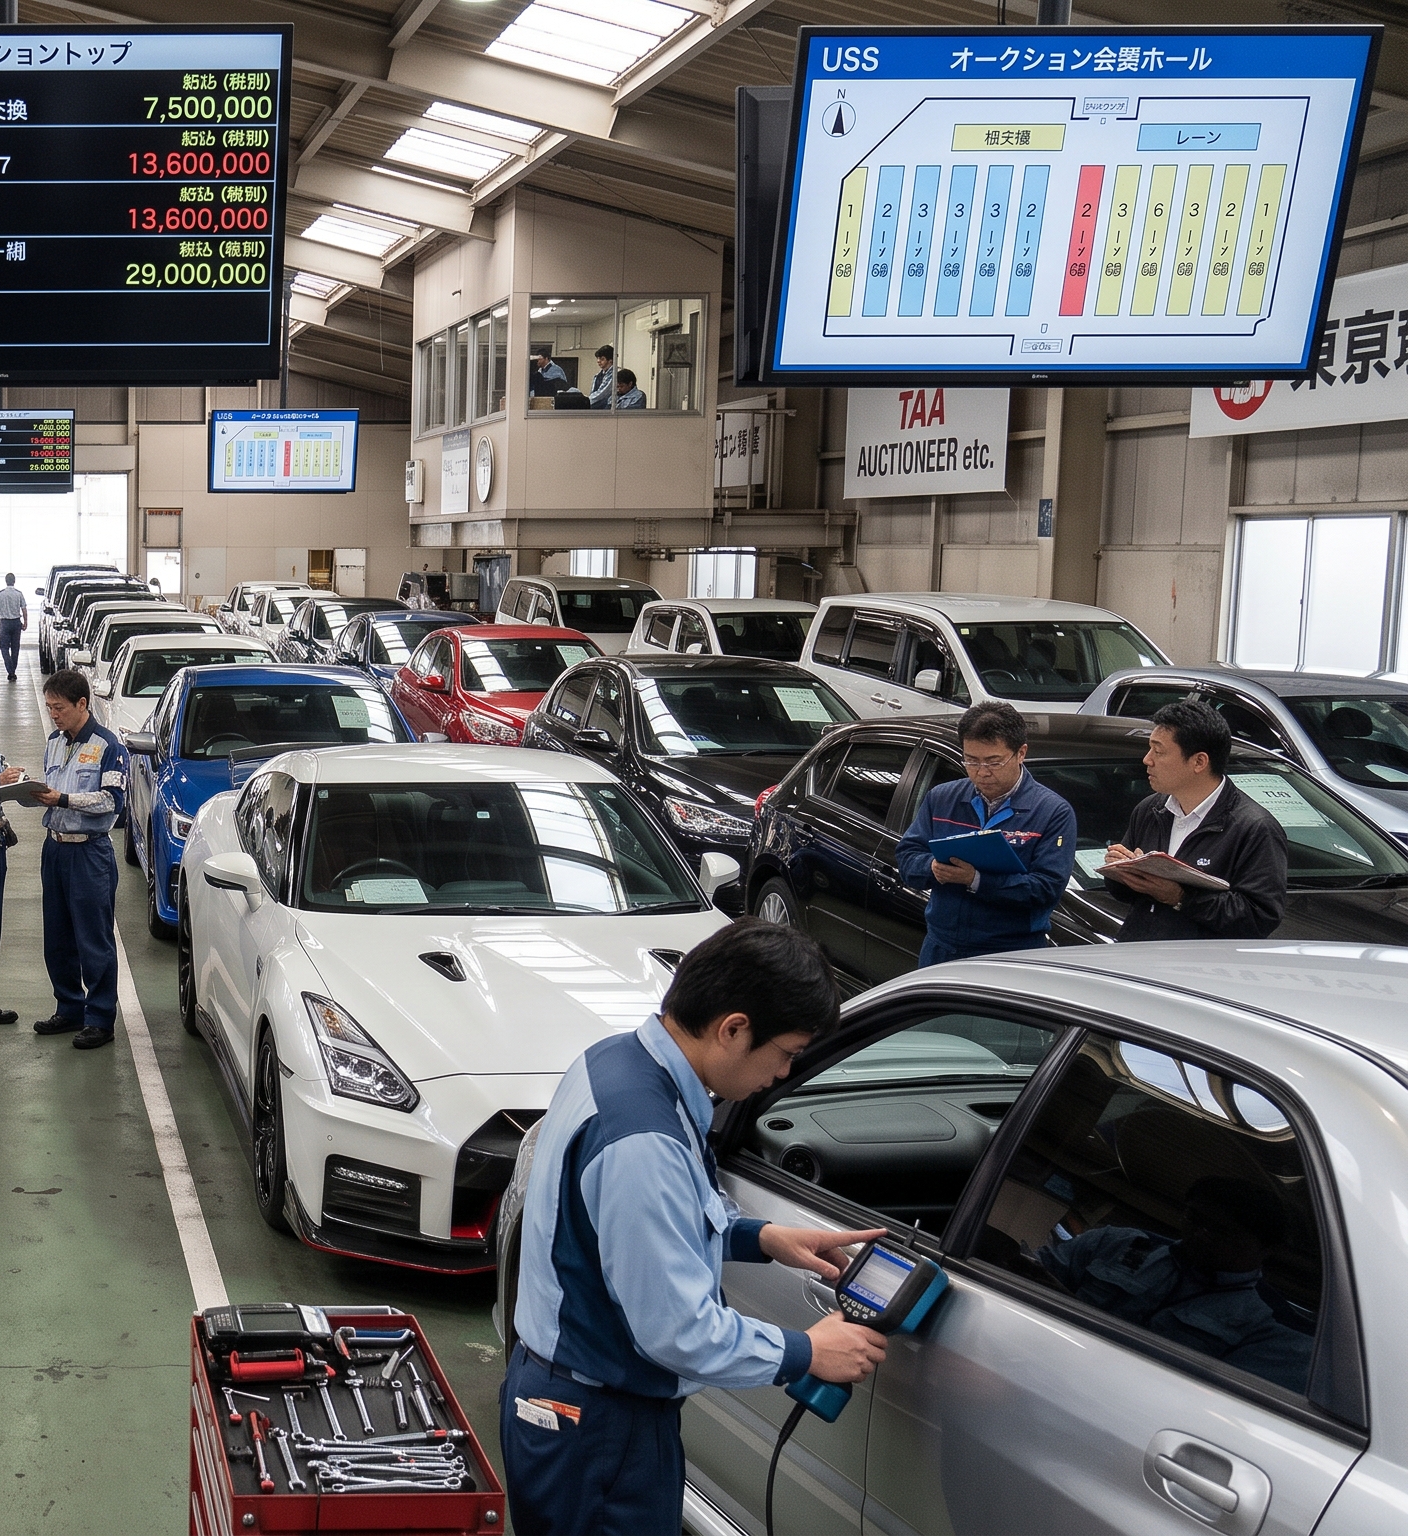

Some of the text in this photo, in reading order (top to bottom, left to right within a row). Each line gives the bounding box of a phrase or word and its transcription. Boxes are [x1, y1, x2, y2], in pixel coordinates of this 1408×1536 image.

[822, 46, 880, 72] USS
[837, 88, 847, 99] N
[143, 95, 273, 124] 7,500,000
[1176, 130, 1222, 146] レーン
[128, 151, 271, 179] 13,600,000
[128, 207, 269, 234] 13,600,000
[125, 263, 267, 289] 29,000,000
[899, 388, 945, 430] TAA
[857, 437, 994, 478] AUCTIONEER etc.
